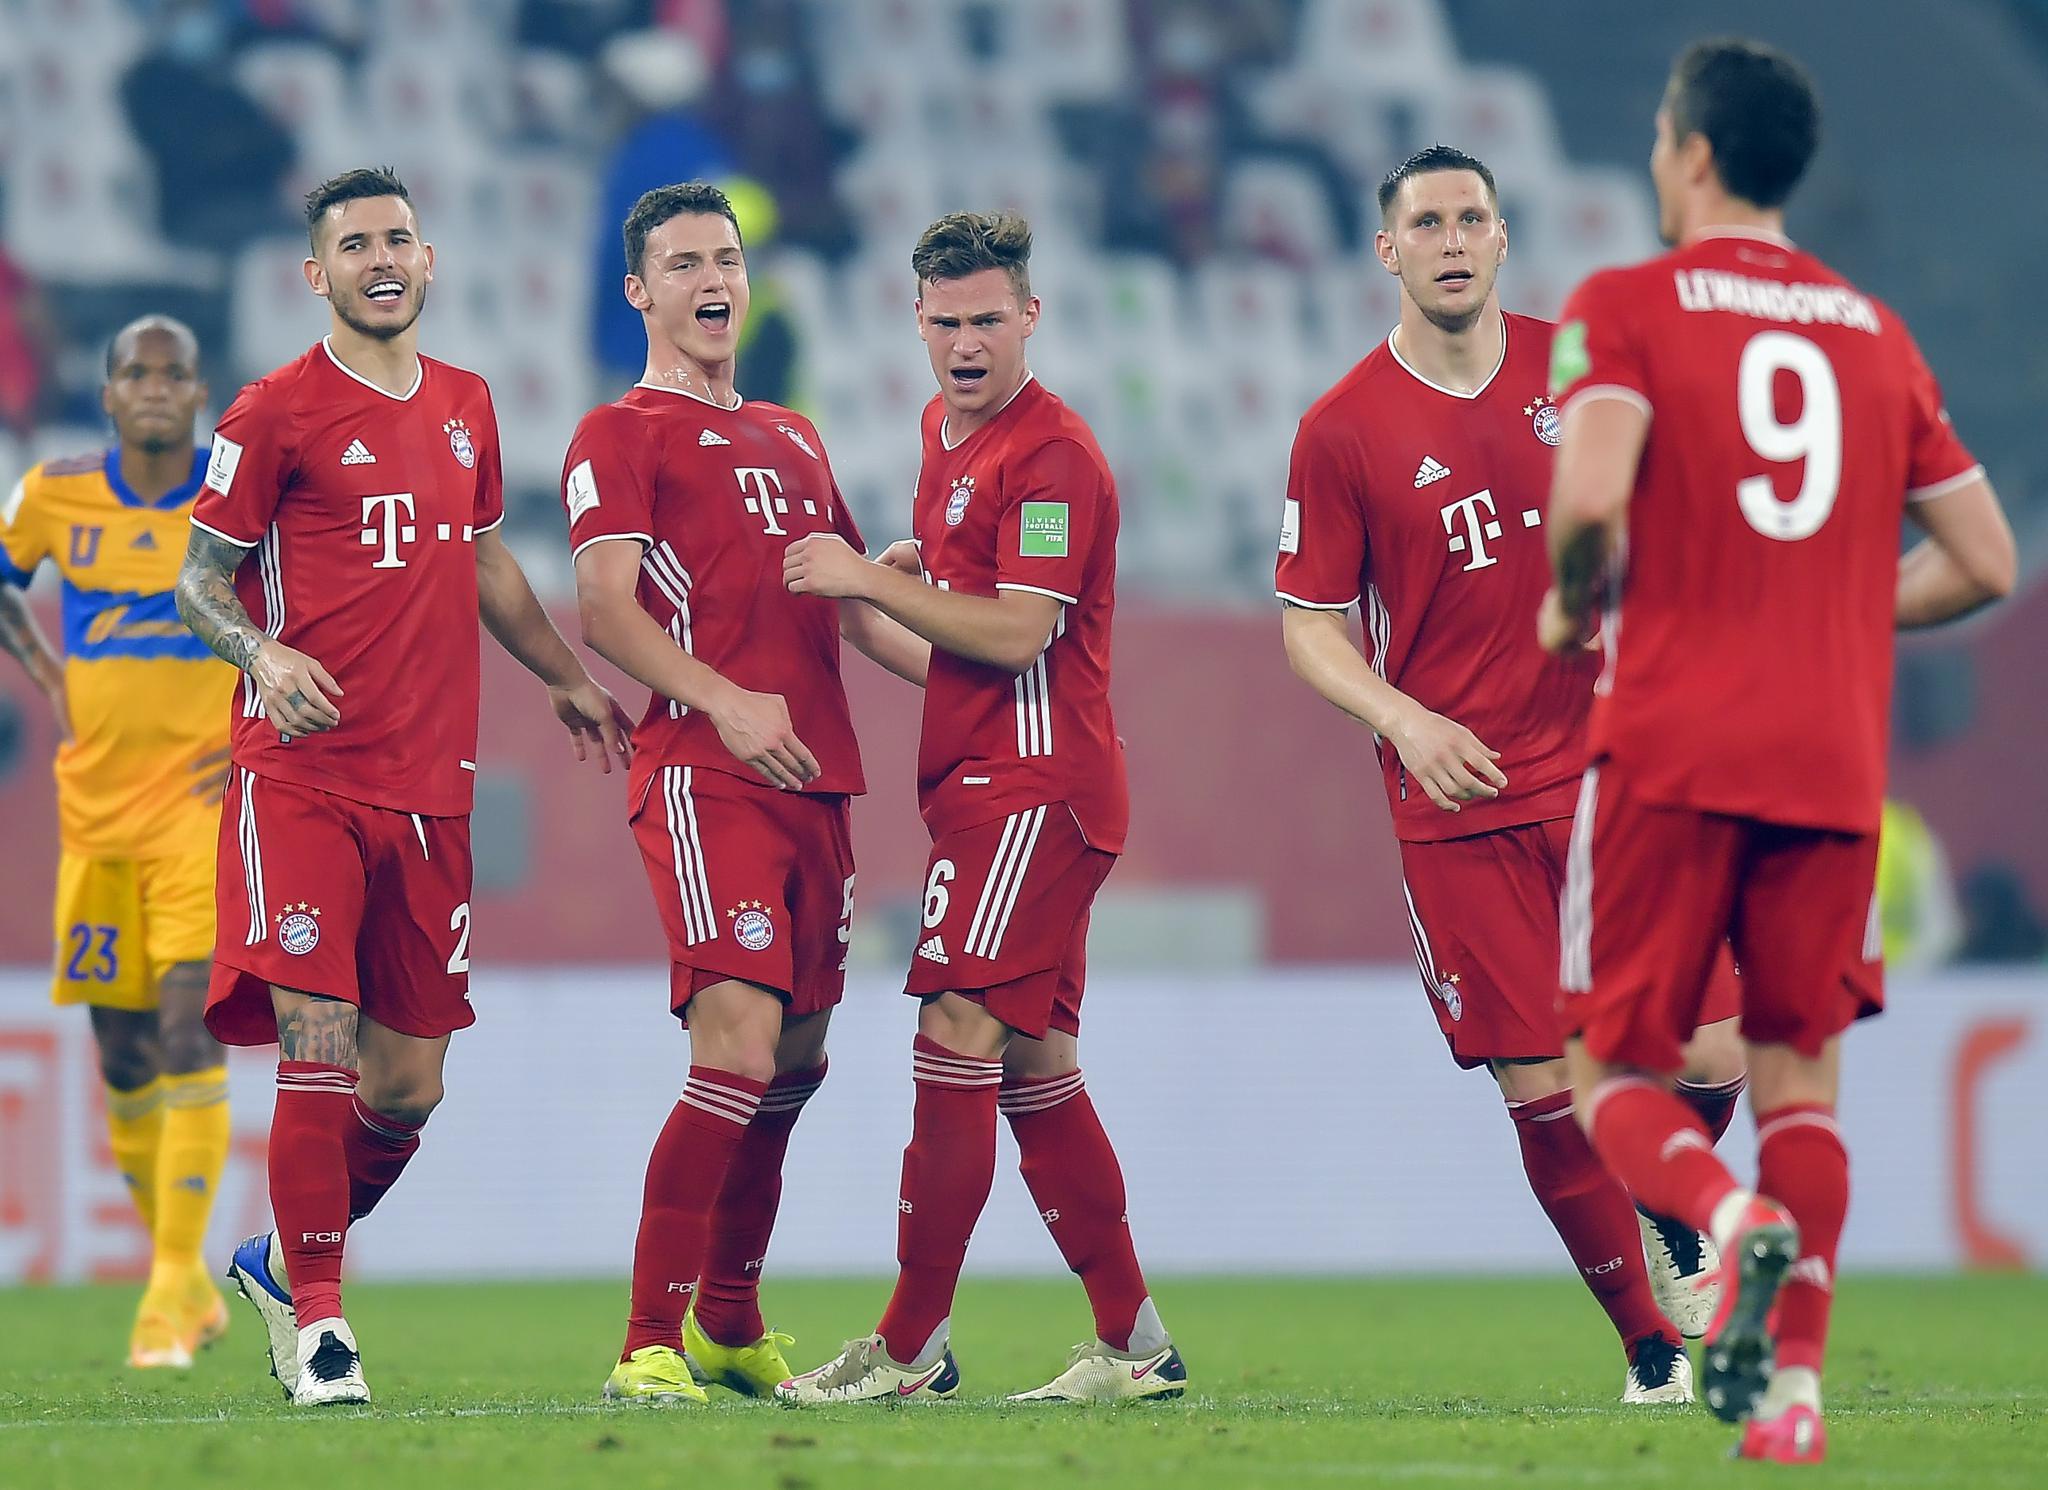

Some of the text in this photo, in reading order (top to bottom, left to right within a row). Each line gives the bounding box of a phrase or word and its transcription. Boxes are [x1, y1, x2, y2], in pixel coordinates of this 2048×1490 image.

[1736, 330, 1844, 542] 9
[734, 467, 789, 536] T
[1413, 466, 1451, 488] adidas
[70, 526, 103, 567] U
[361, 492, 416, 568] T
[1440, 488, 1502, 572] T
[924, 859, 955, 928] 6
[68, 923, 117, 982] 23
[918, 947, 949, 965] adidas
[302, 1231, 342, 1243] FCB
[1585, 1256, 1623, 1275] FCB
